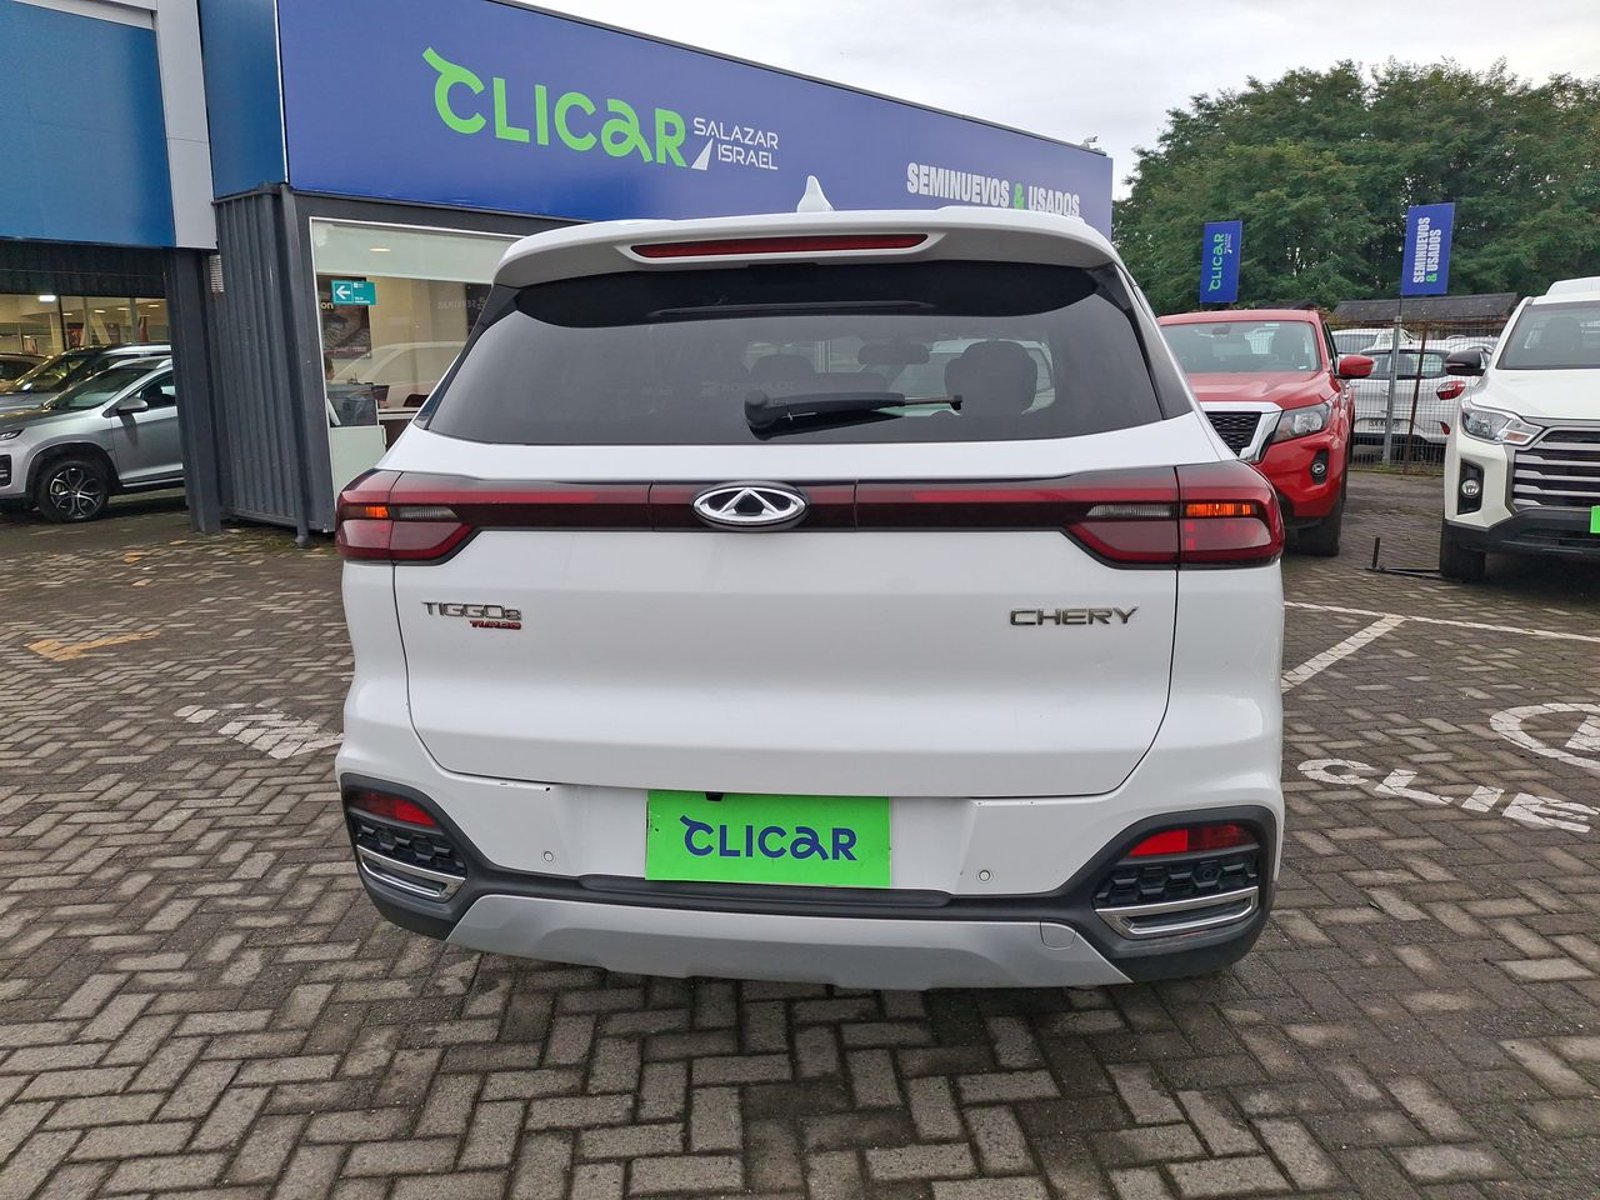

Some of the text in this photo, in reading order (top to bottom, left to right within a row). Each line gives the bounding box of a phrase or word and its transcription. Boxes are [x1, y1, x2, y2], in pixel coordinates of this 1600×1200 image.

[693, 117, 779, 150] SALAZAR
[717, 143, 779, 171] ISRAEL
[906, 162, 1080, 217] SEMINUEVOS & USADOS
[1412, 216, 1431, 283] SEMINUEVOS
[1426, 229, 1442, 272] USADOS
[1009, 606, 1139, 626] CHERY
